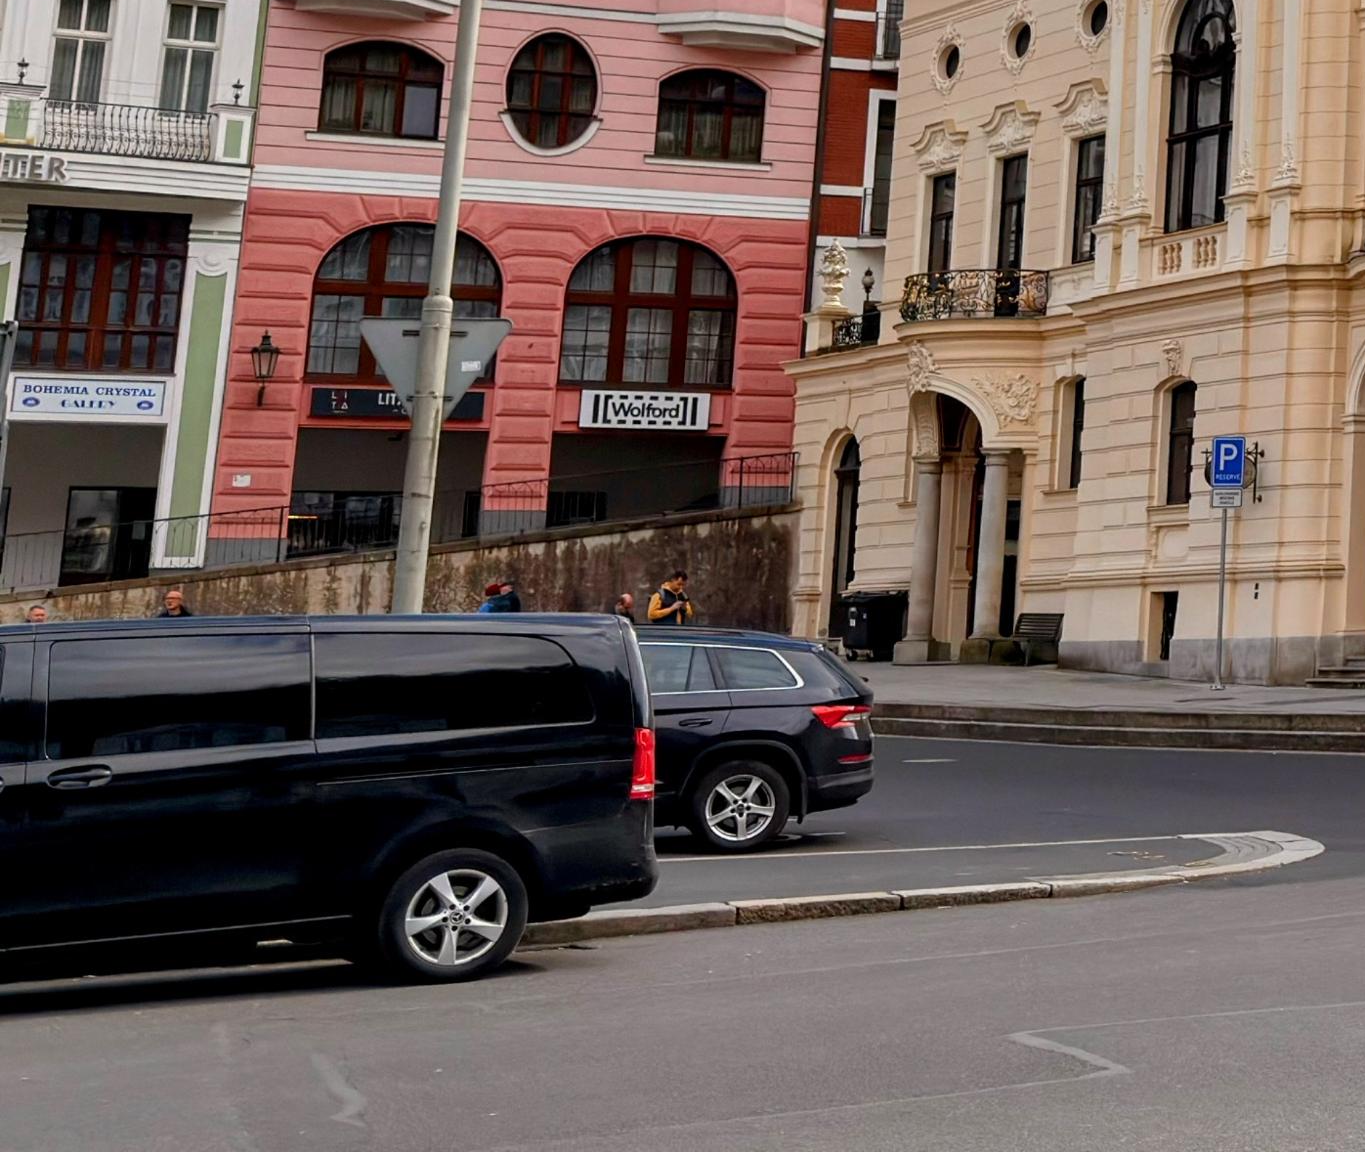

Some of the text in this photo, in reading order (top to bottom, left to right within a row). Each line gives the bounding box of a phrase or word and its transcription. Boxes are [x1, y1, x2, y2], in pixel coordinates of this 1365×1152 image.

[0, 152, 68, 182] TER
[23, 384, 156, 397] BOHEMIA CRYSTAL
[378, 392, 401, 406] LIT
[612, 401, 680, 418] Wolford
[1220, 443, 1238, 471] P
